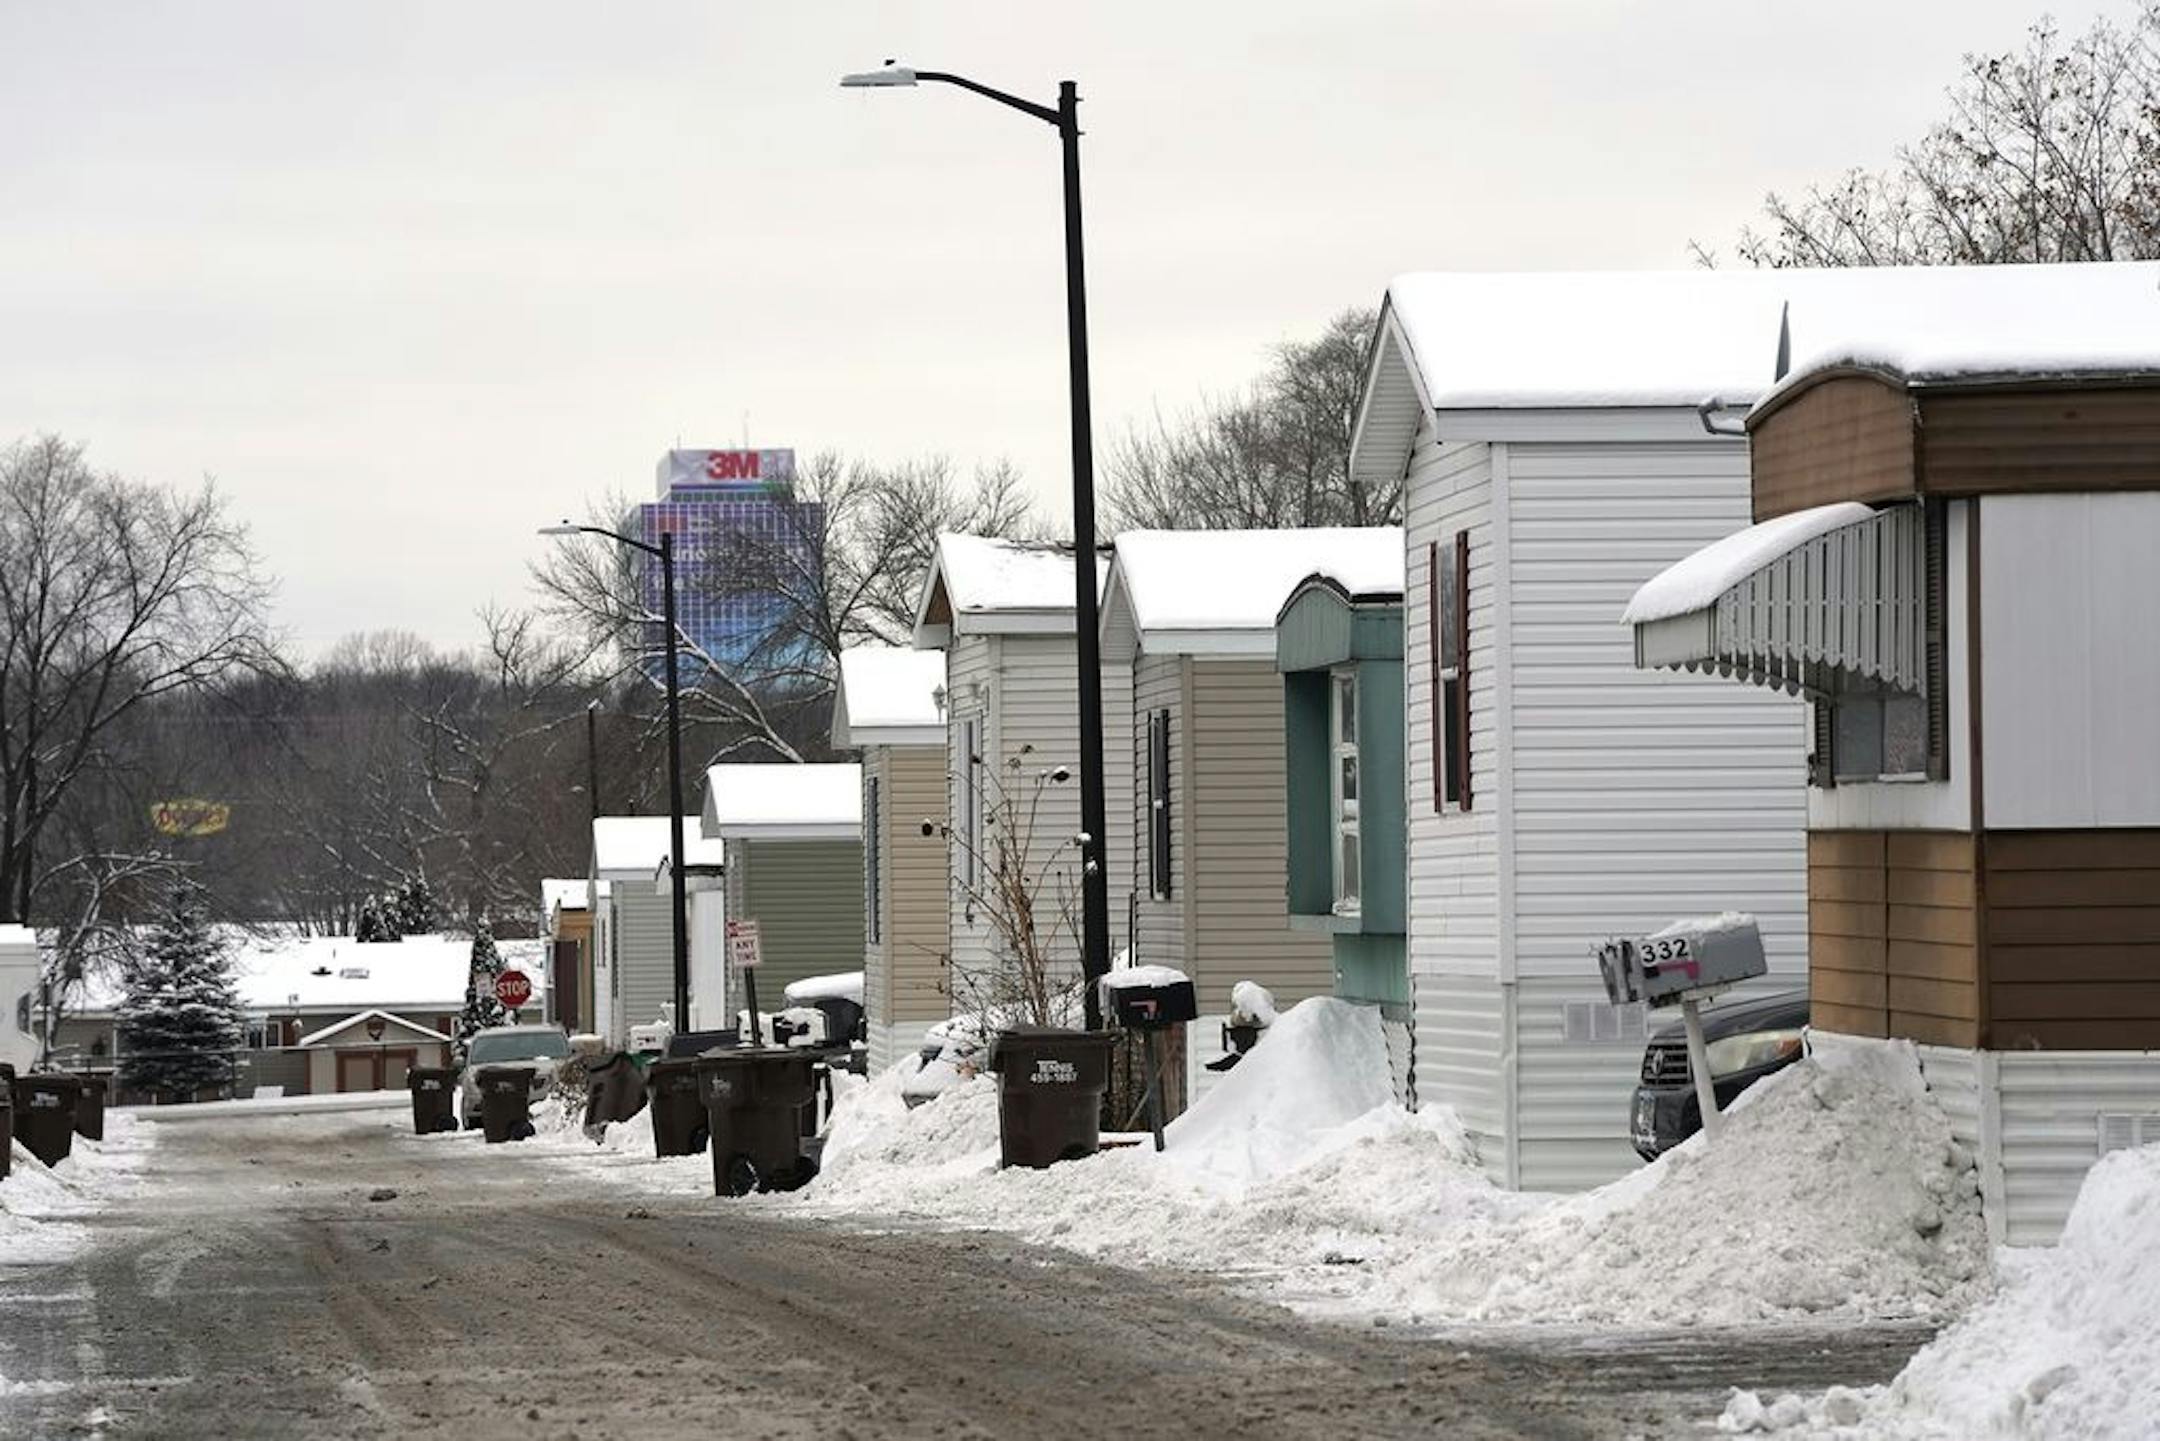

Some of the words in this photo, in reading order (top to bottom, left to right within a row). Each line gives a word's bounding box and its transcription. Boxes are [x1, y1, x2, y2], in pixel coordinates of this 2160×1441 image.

[707, 451, 759, 479] 3M
[735, 940, 754, 950] ANY
[1641, 938, 1688, 962] 332
[496, 980, 529, 997] STOP
